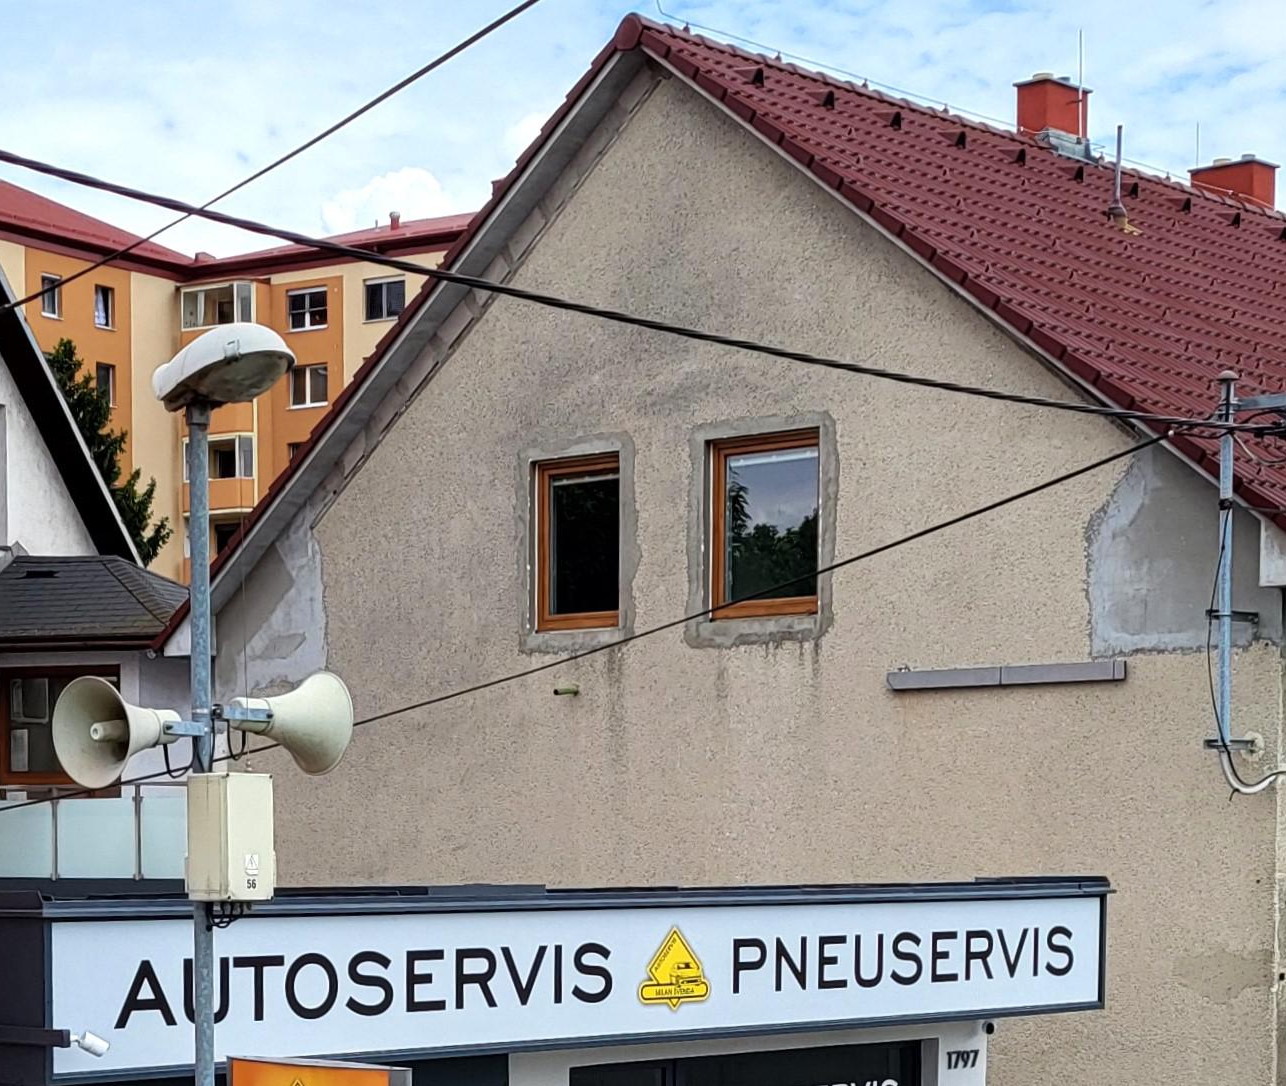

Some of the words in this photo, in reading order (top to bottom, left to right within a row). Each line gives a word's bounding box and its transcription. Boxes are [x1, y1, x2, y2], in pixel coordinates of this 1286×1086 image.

[247, 879, 257, 889] 56
[114, 942, 613, 1029] AUTOSERVIS
[733, 926, 1074, 994] PNEUSERVIS
[946, 1050, 980, 1070] 1797
